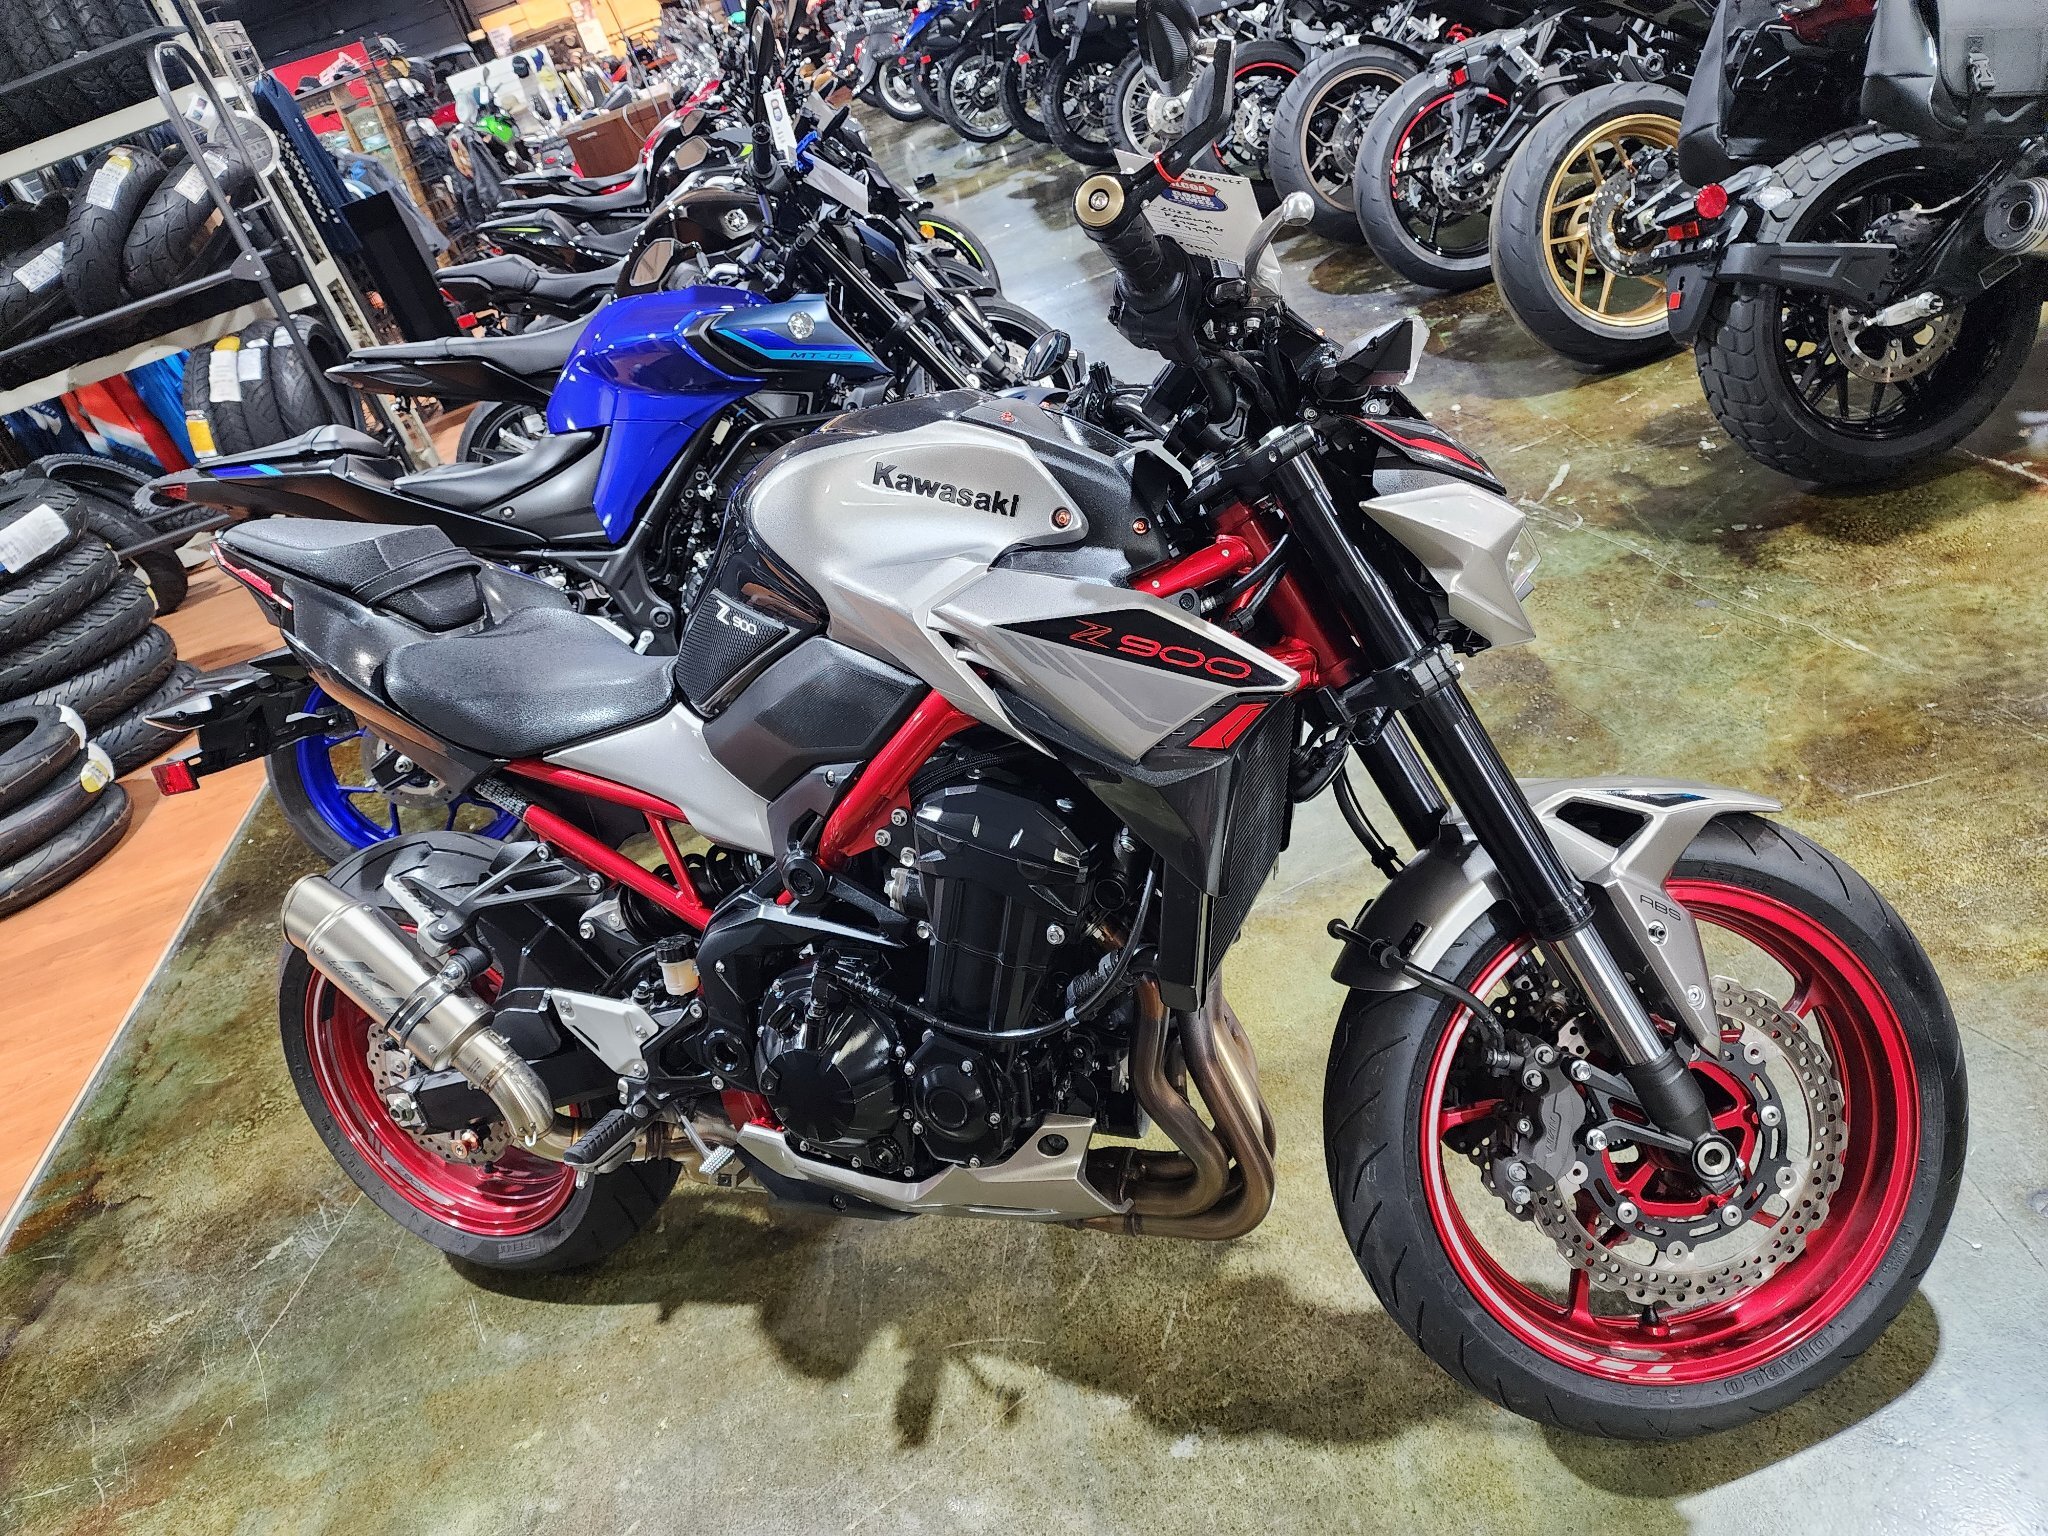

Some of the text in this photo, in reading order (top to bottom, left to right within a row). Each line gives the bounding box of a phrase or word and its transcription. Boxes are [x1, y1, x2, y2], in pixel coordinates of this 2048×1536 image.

[790, 352, 853, 360] MT-03
[872, 461, 1020, 517] Kawasaki
[1640, 894, 1681, 921] ABS
[1724, 1332, 1833, 1396] DIABLO
